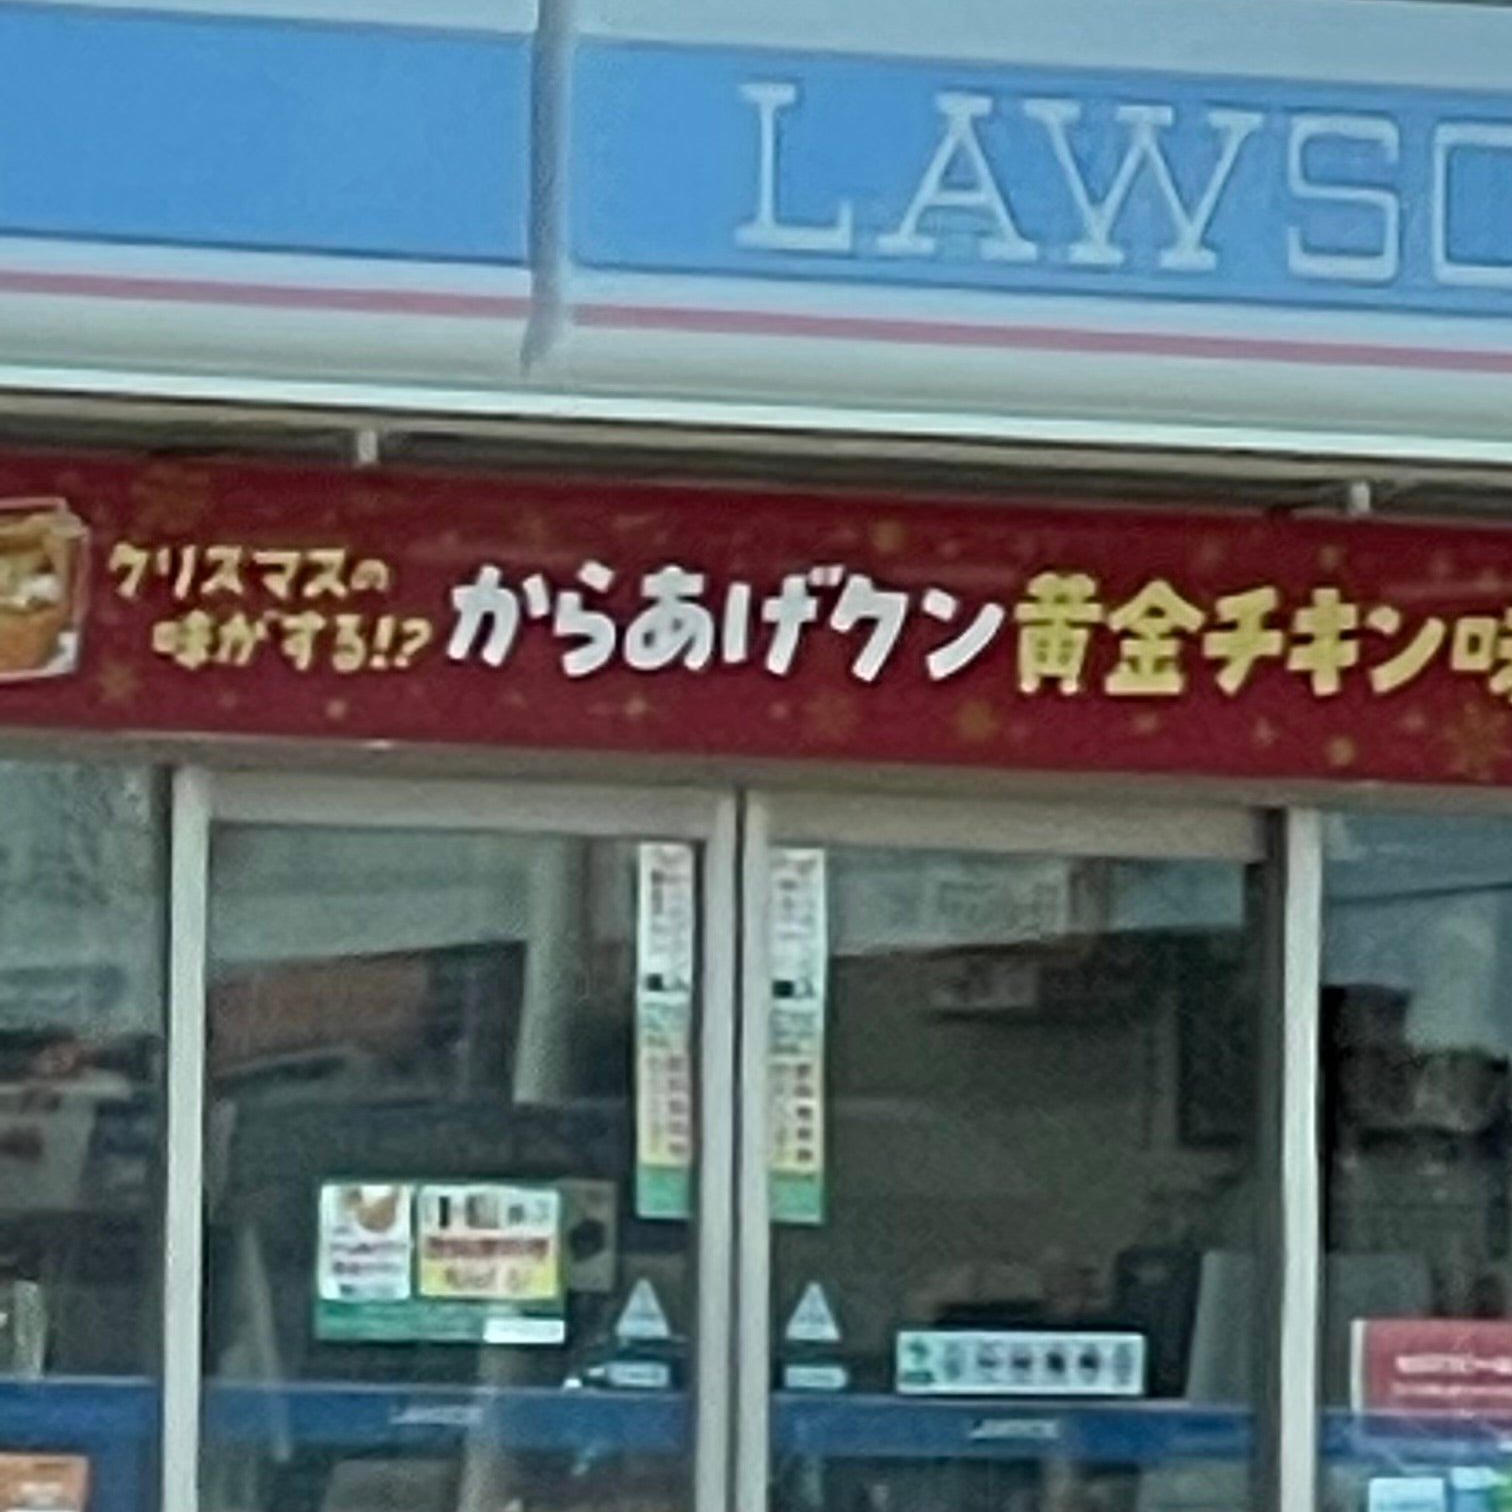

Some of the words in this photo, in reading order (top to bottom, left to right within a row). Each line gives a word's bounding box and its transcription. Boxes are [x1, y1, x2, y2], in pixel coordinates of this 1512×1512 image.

[108, 542, 391, 600] クリスマスの
[151, 608, 435, 672] 味がする!?
